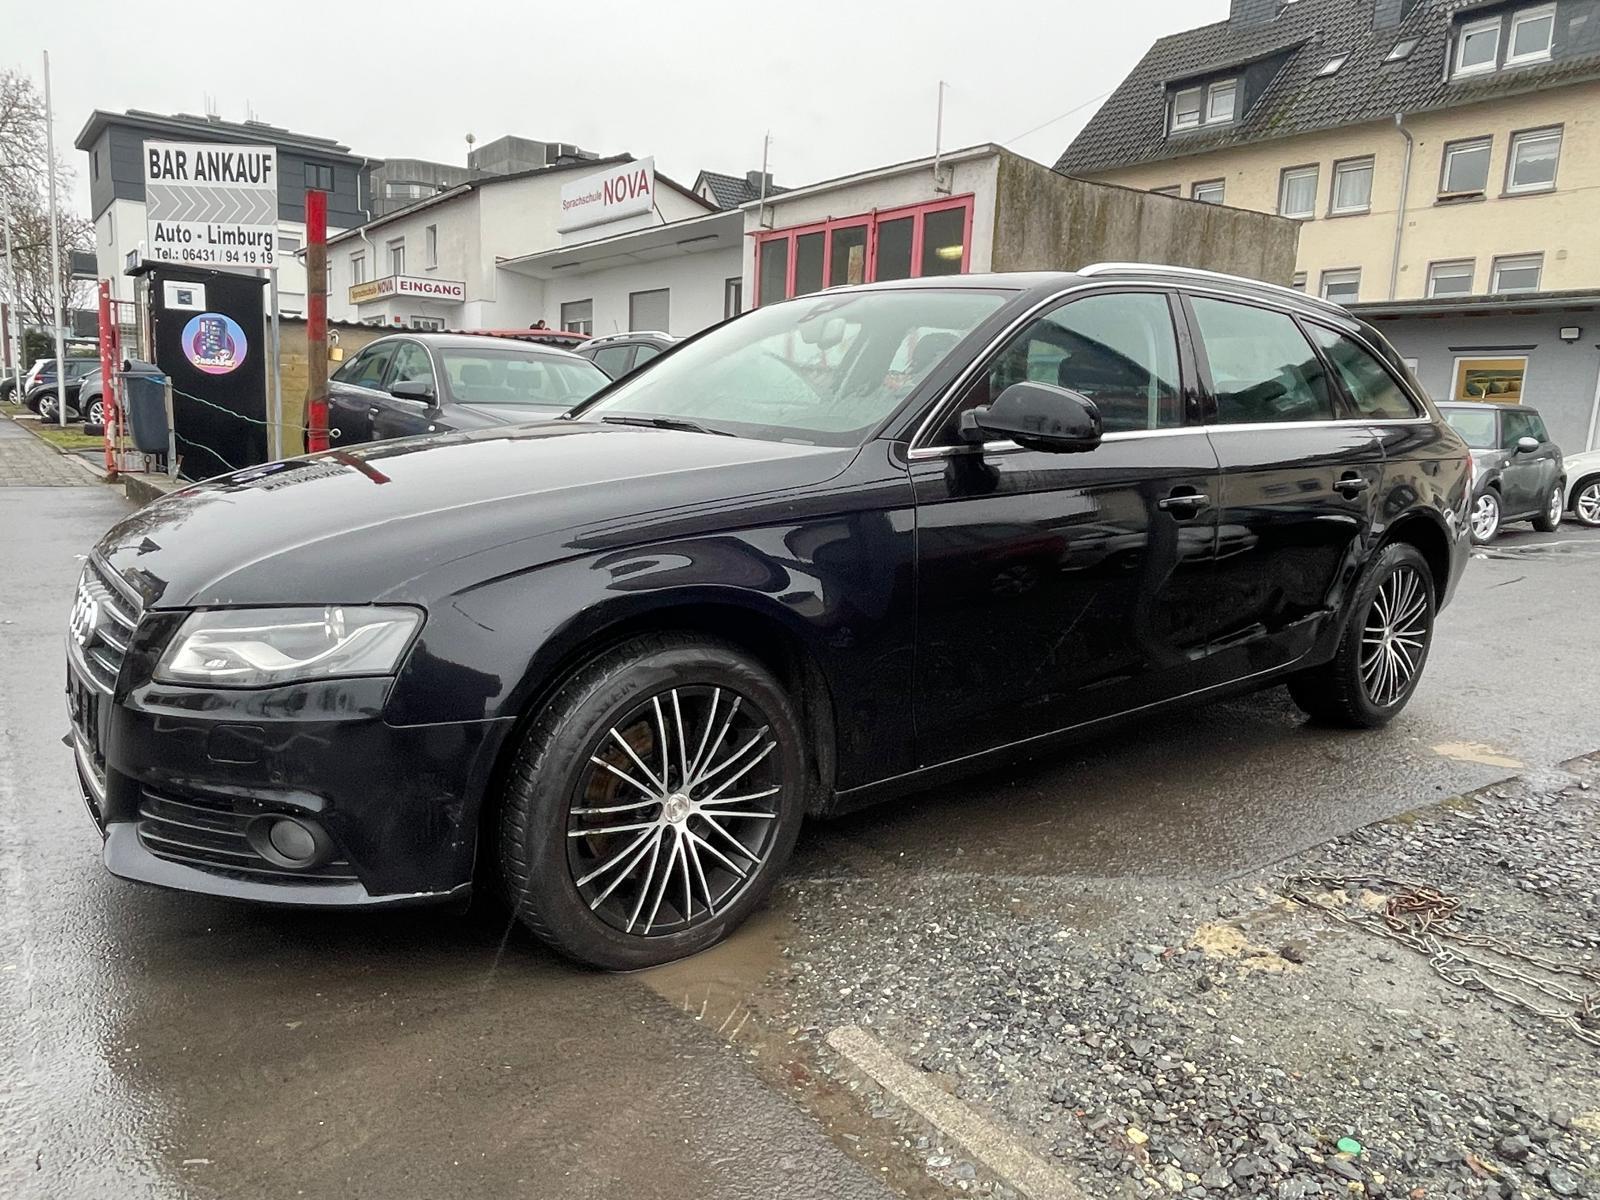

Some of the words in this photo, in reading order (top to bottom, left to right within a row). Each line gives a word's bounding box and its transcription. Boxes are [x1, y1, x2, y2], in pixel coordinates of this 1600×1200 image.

[148, 148, 188, 181] BAR
[194, 151, 272, 184] ANKAUF
[562, 190, 602, 210] Sprachschule
[603, 169, 650, 206] NOVA
[154, 222, 192, 243] Auto
[207, 225, 273, 252] Limburg
[155, 248, 179, 260] Tel.:
[182, 248, 216, 262] 06431
[225, 250, 240, 263] 94
[243, 251, 257, 263] 19
[260, 252, 274, 264] 19
[400, 281, 461, 296] EINGANG
